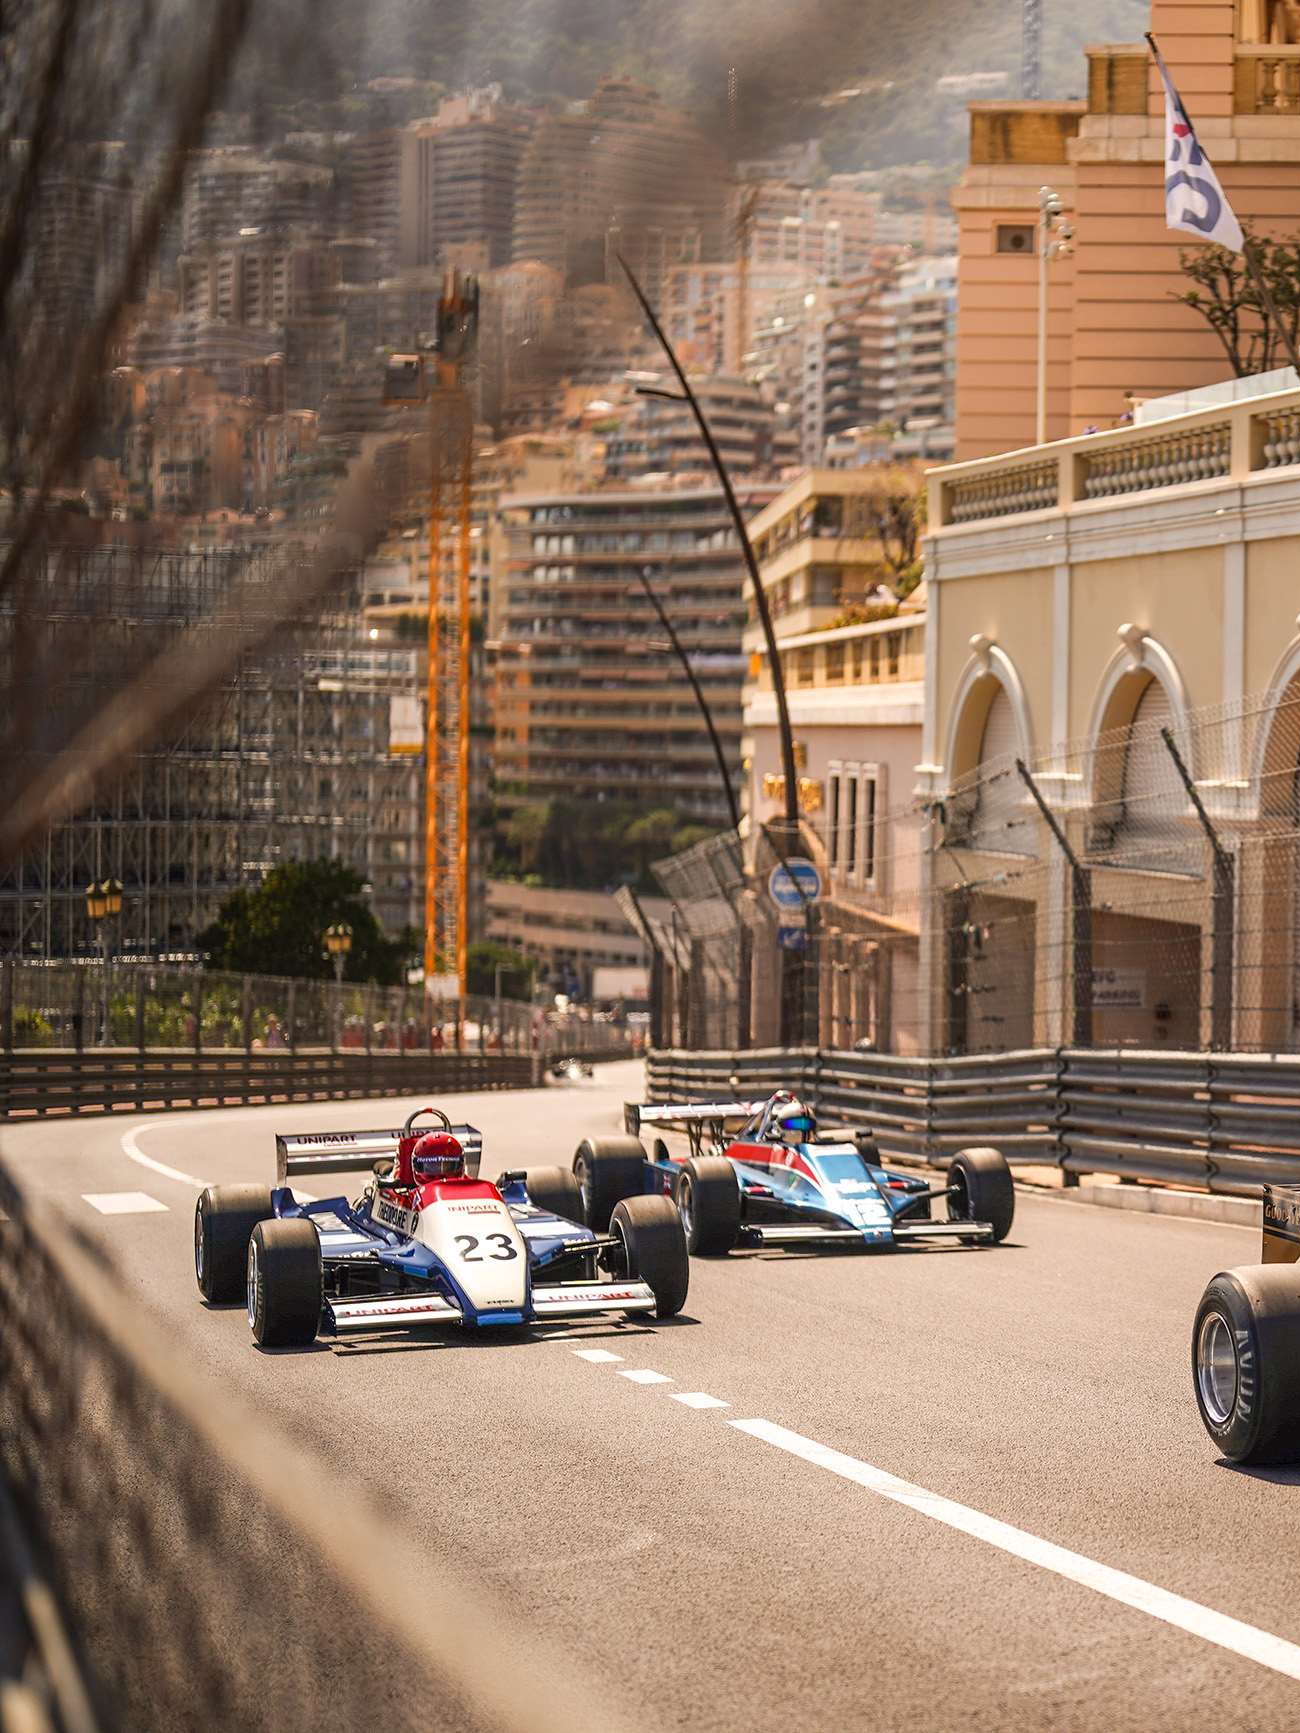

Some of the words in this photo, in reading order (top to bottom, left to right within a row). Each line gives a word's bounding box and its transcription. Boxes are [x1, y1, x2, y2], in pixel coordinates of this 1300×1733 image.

[296, 1134, 357, 1145] UNIPART
[448, 1205, 501, 1214] UNIPART
[454, 1233, 518, 1262] 23
[547, 1291, 636, 1304] UNIPART
[344, 1303, 435, 1318] UNIPART
